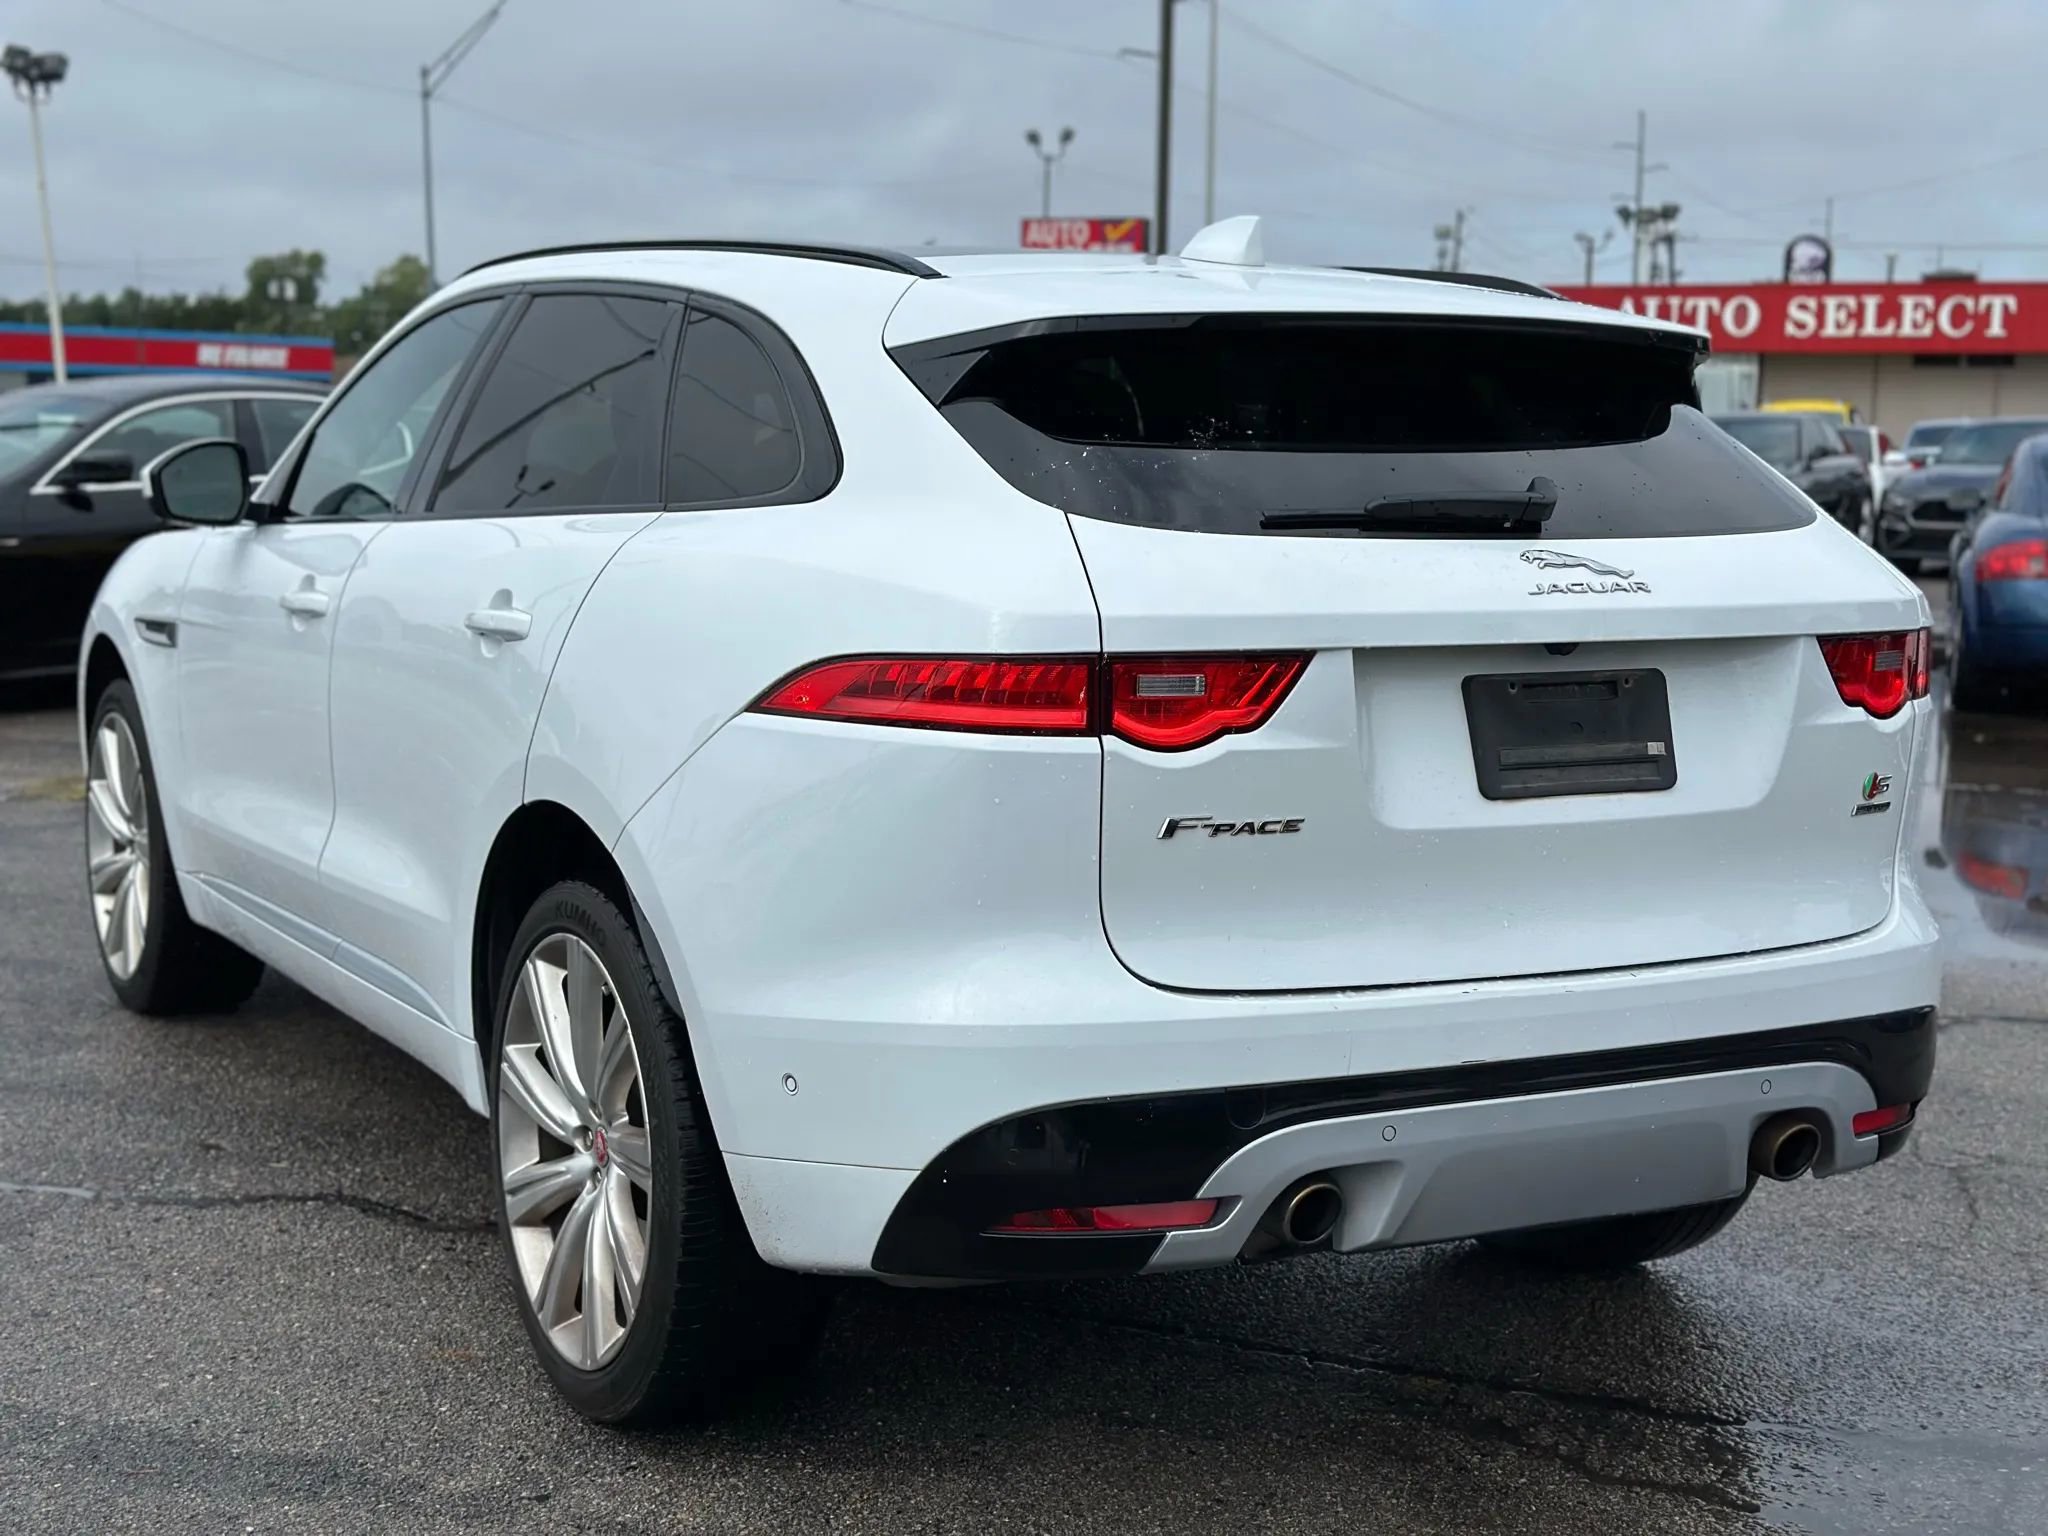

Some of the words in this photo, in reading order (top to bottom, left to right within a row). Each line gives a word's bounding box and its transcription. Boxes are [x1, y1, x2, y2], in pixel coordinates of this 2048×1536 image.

[1025, 220, 1091, 249] AUTO
[1784, 295, 2018, 339] SELECT
[1528, 581, 1652, 595] JAGUAR
[554, 900, 608, 946] KUMHO
